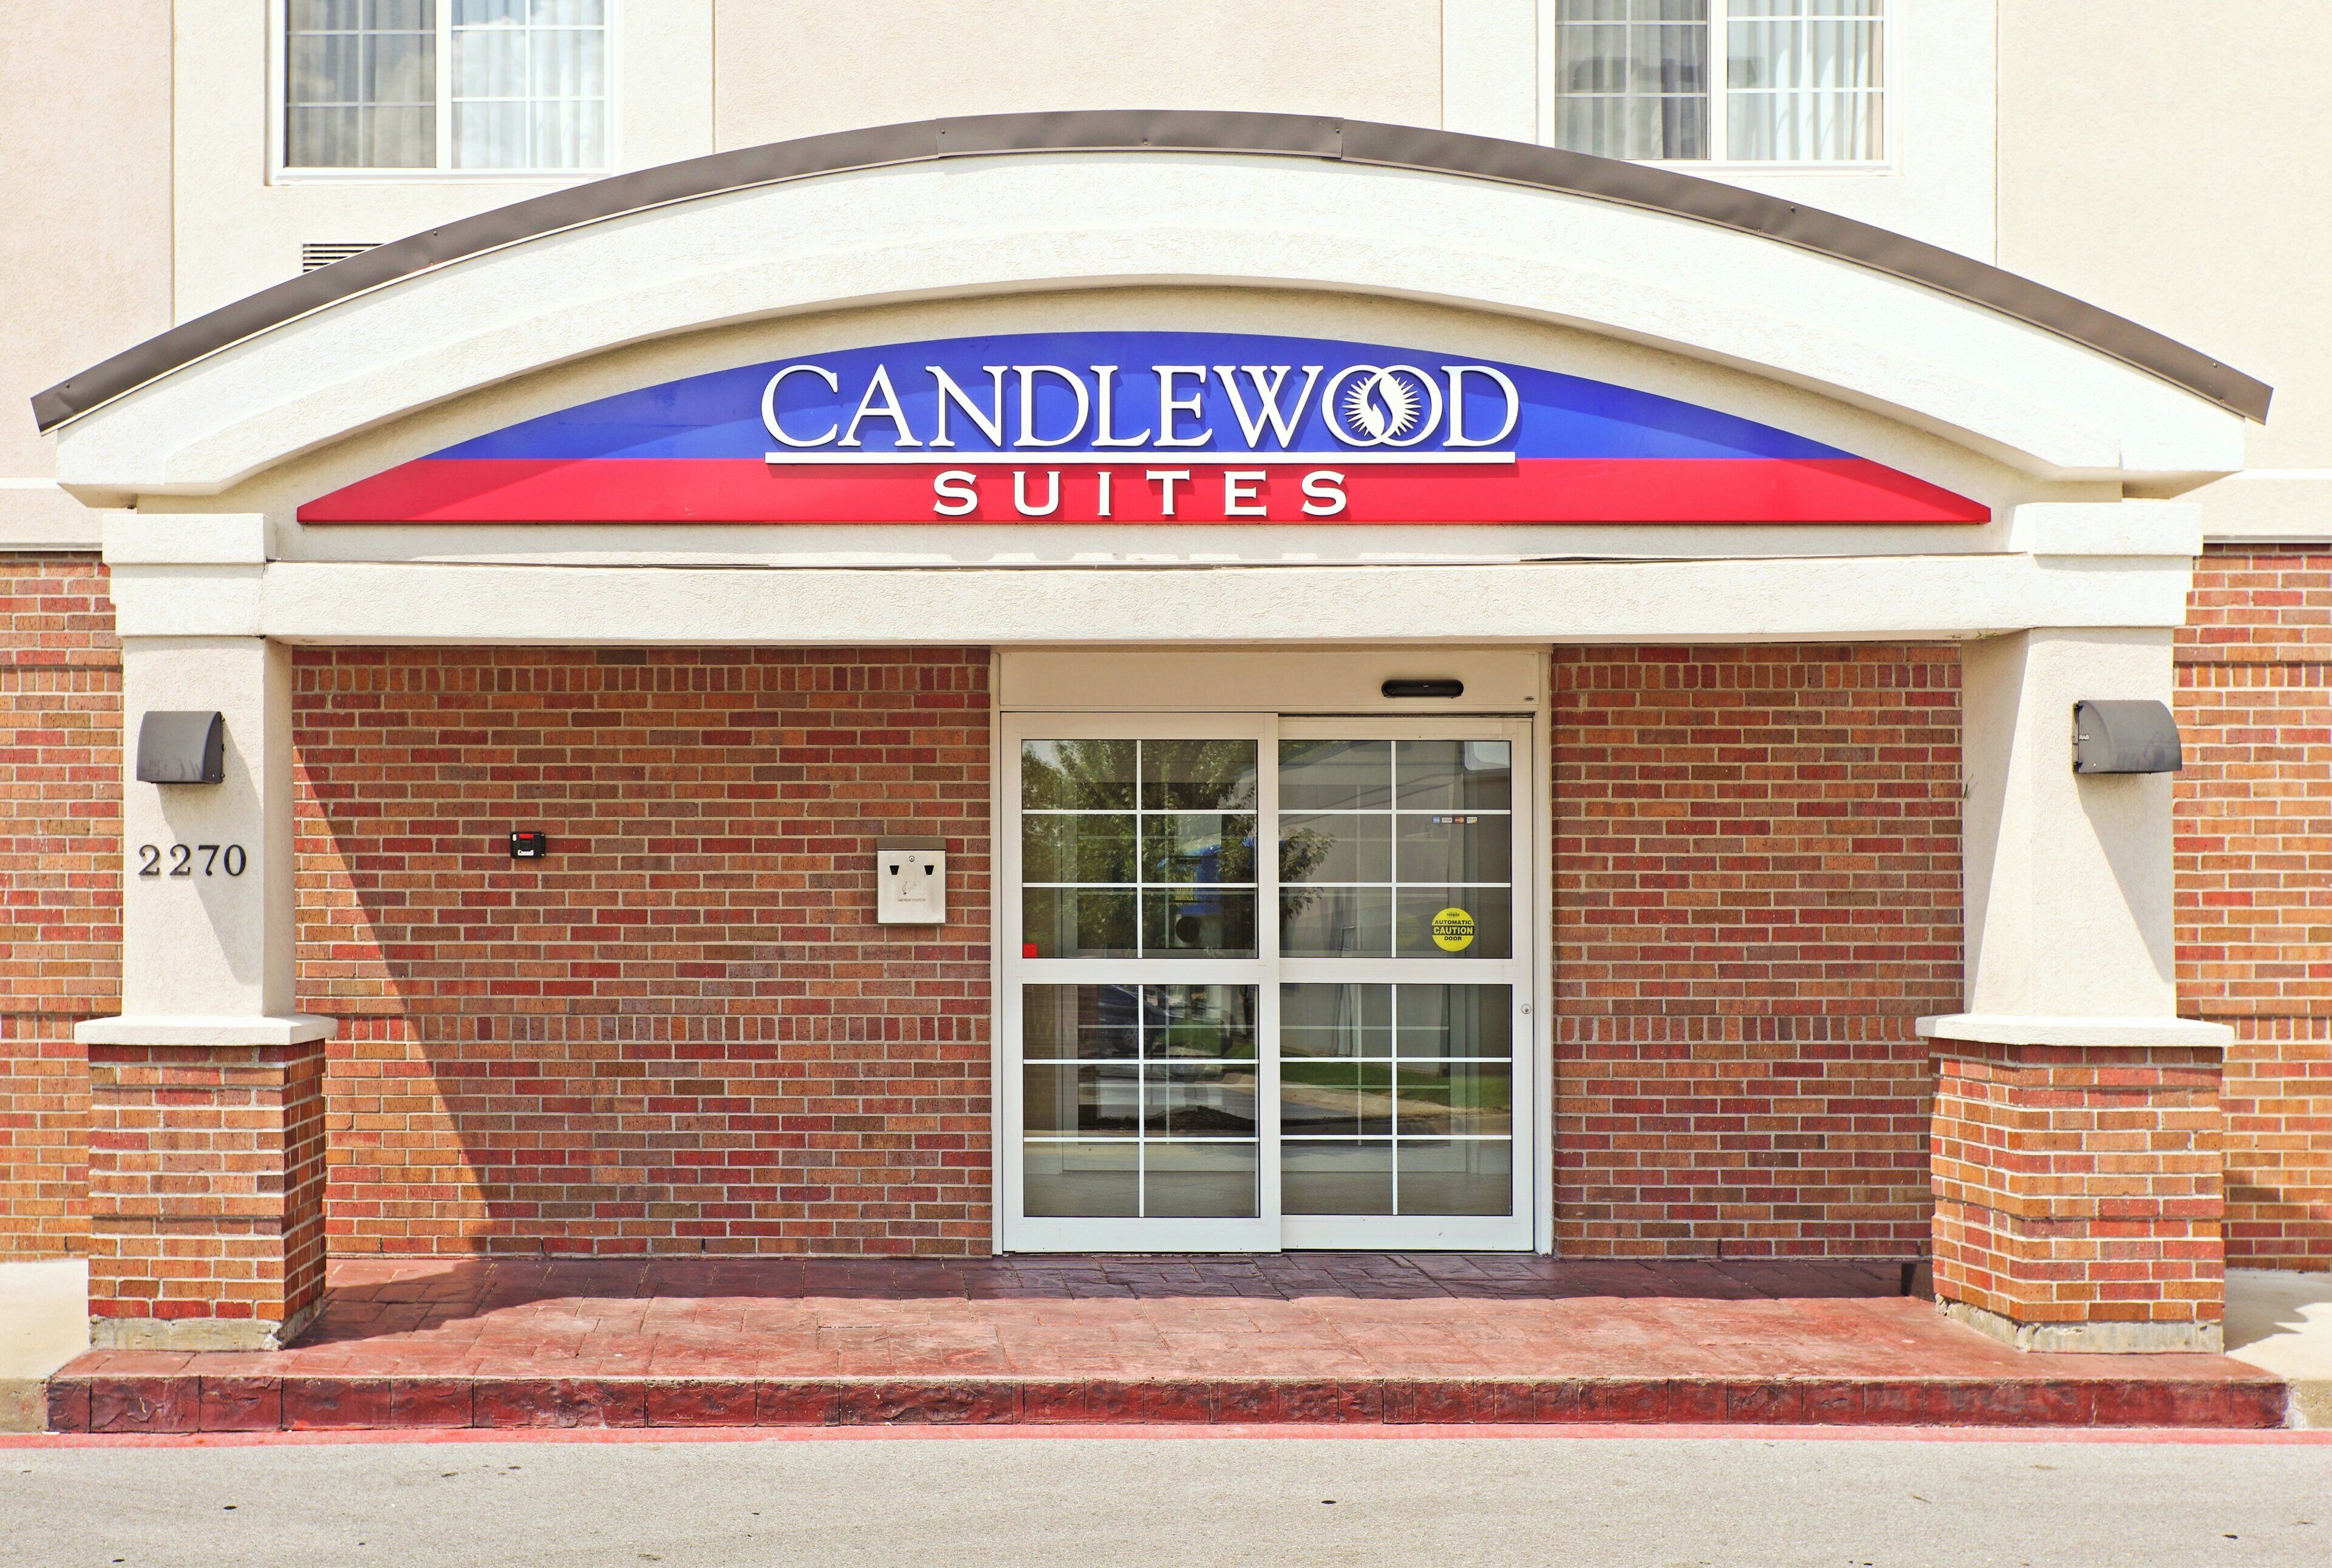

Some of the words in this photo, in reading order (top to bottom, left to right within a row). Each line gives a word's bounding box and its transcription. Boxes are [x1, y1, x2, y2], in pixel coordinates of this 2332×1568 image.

[760, 364, 1519, 448] CANDLEWOOD
[933, 469, 1346, 516] SUITES
[138, 844, 246, 876] 2270
